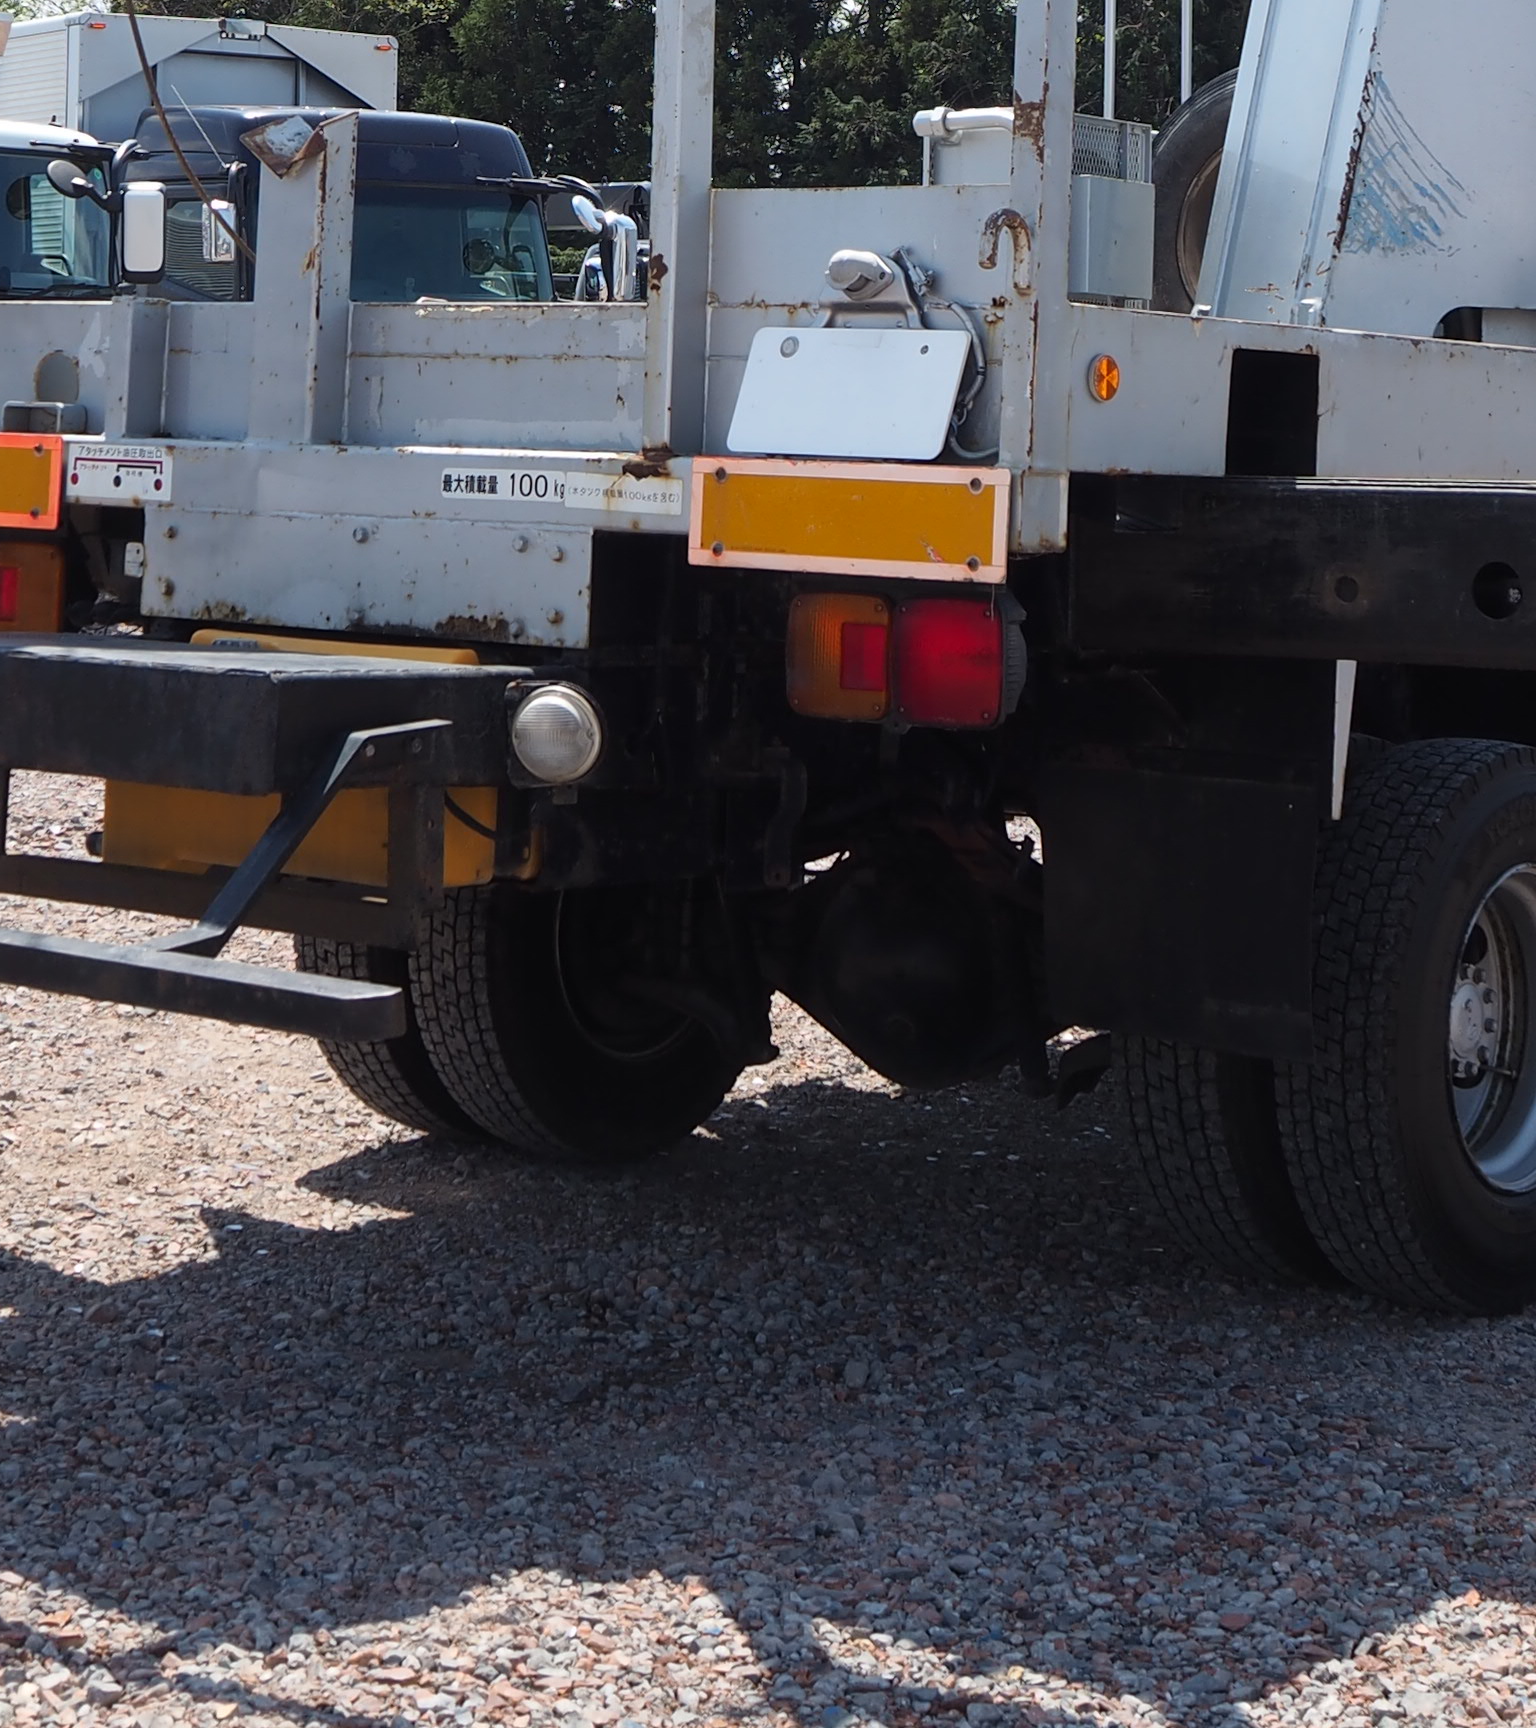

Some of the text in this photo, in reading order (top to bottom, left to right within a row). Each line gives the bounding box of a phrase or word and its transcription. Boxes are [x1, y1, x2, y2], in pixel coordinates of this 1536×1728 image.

[442, 473, 565, 499] 最大積載量 100 kg
